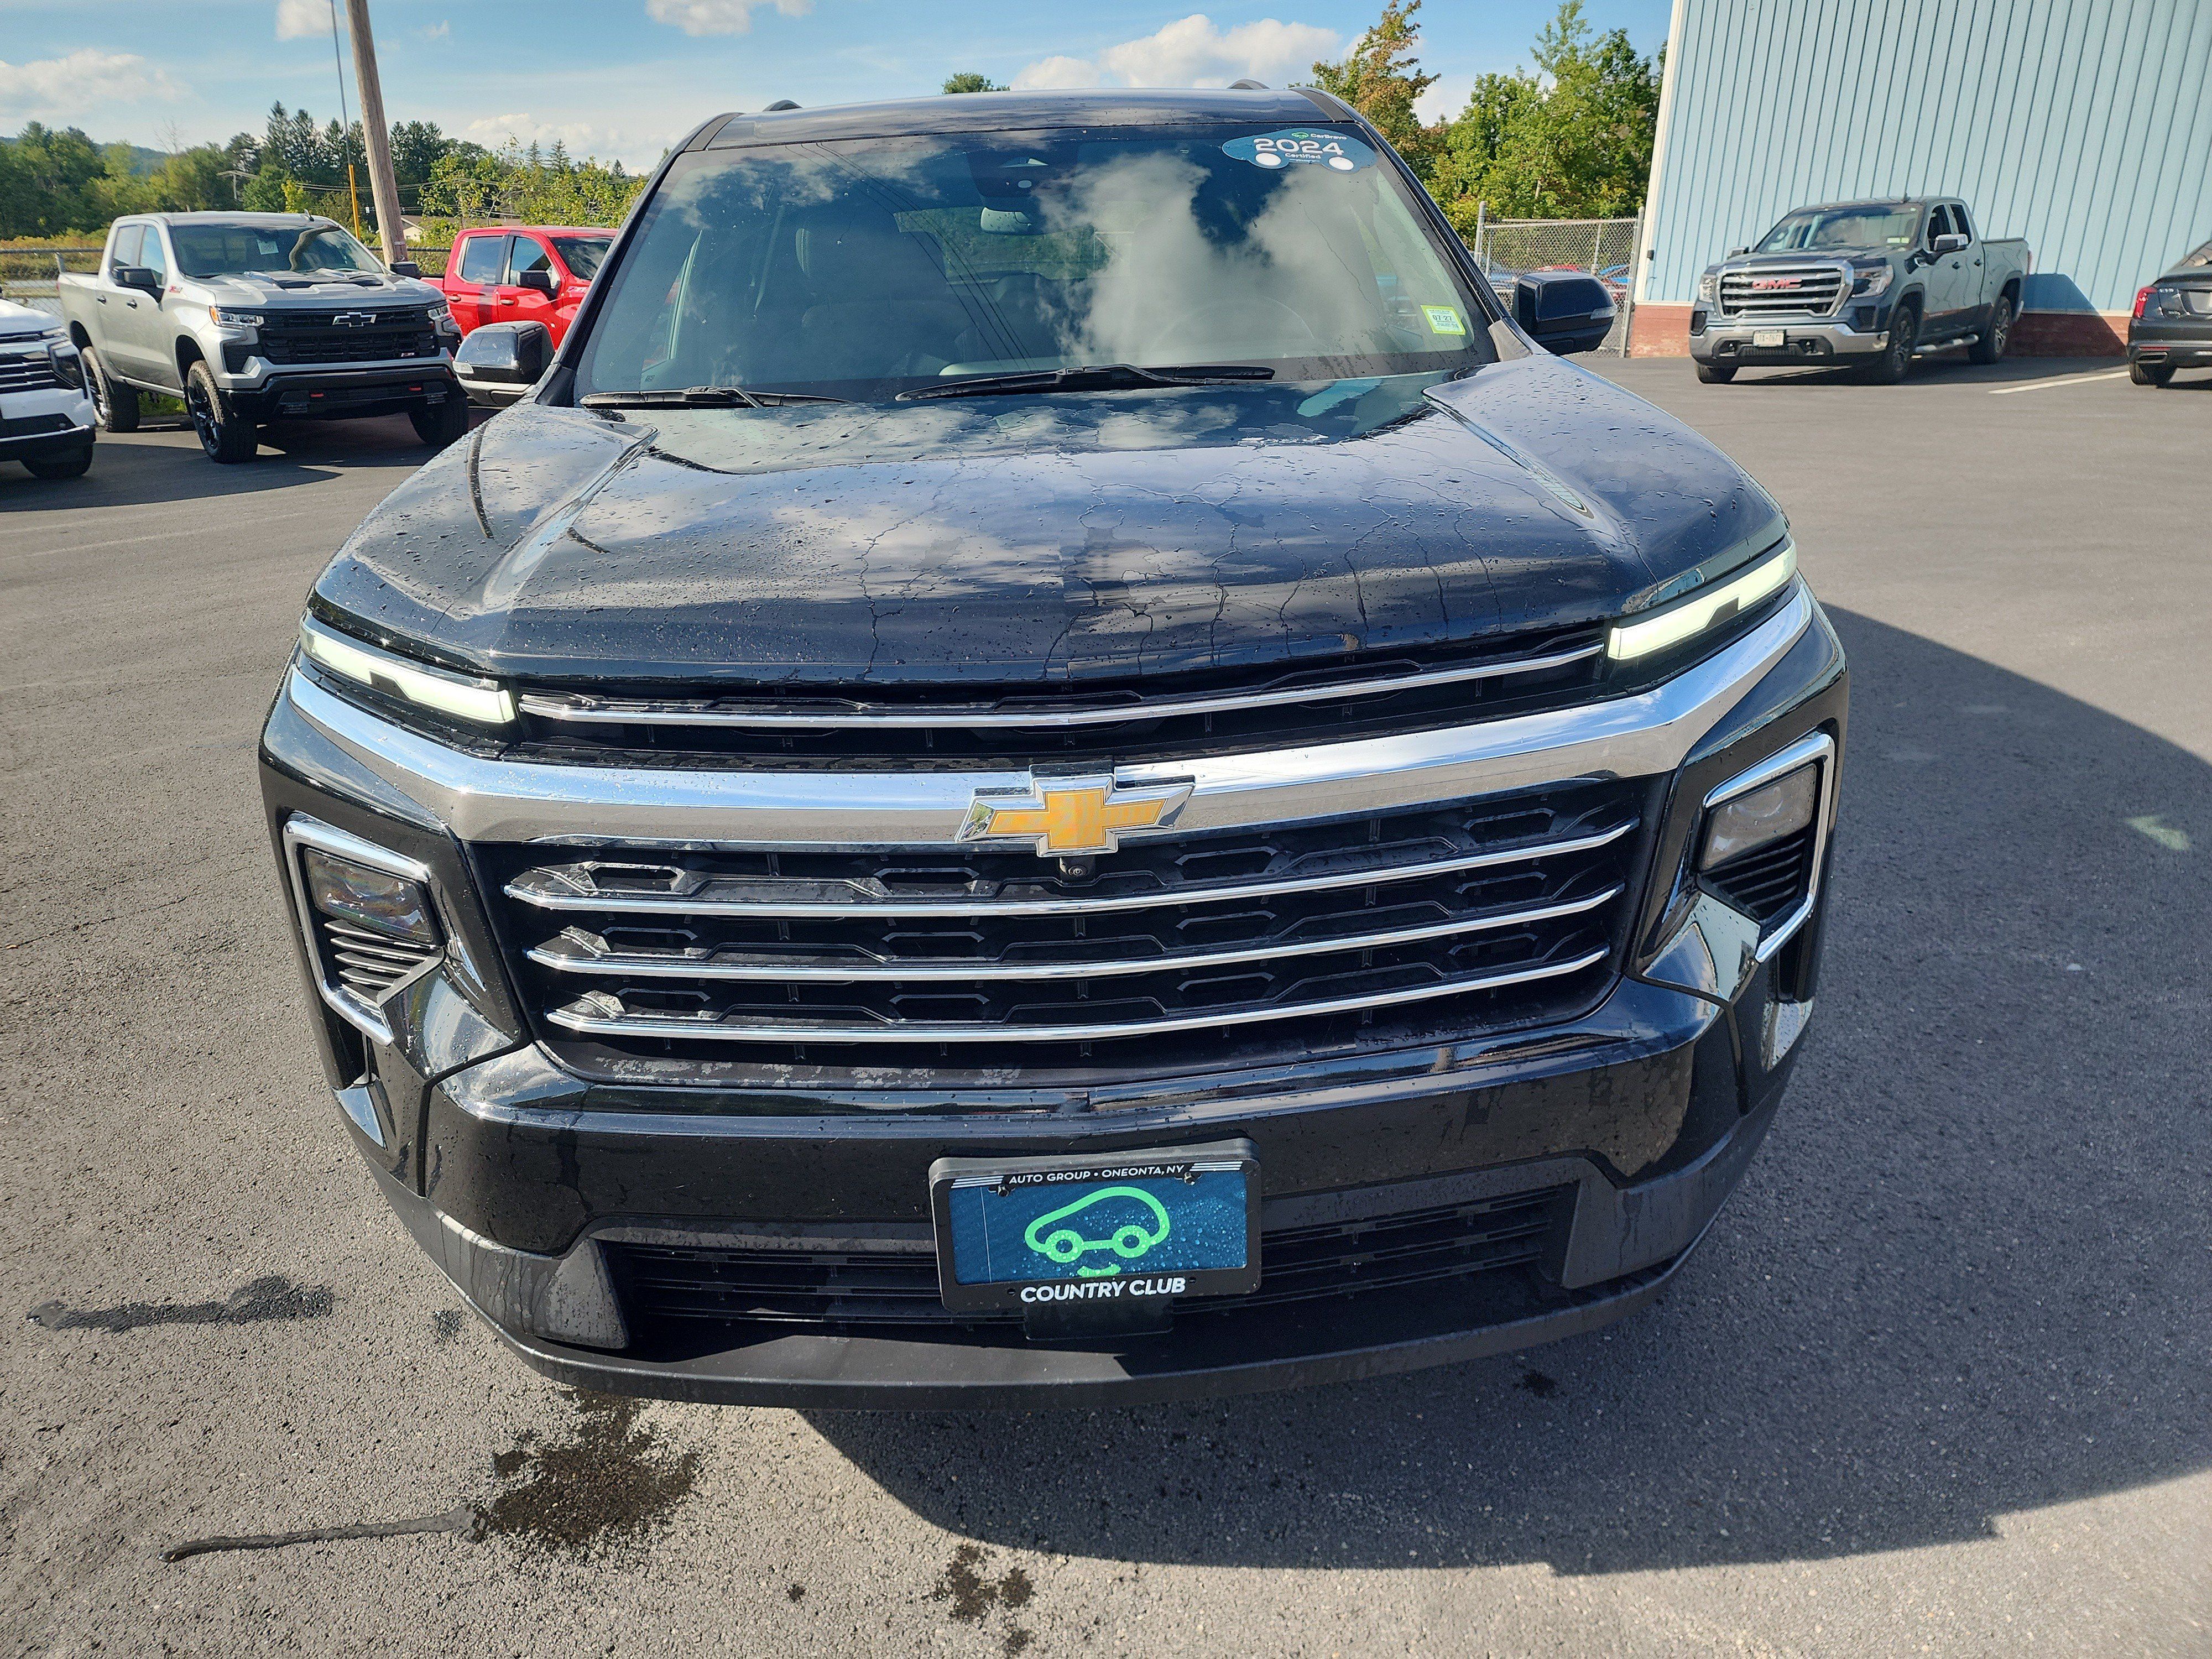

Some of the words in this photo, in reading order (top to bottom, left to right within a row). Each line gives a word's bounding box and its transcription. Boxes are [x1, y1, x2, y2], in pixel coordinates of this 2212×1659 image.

[1253, 138, 1344, 155] 2024
[1752, 278, 1803, 290] GMC
[1009, 1175, 1043, 1185] AUTO
[1046, 1170, 1091, 1182] GROUP
[1166, 1165, 1185, 1173] NY
[1020, 1280, 1127, 1303] COUNTRY
[1129, 1277, 1186, 1296] CLUB
